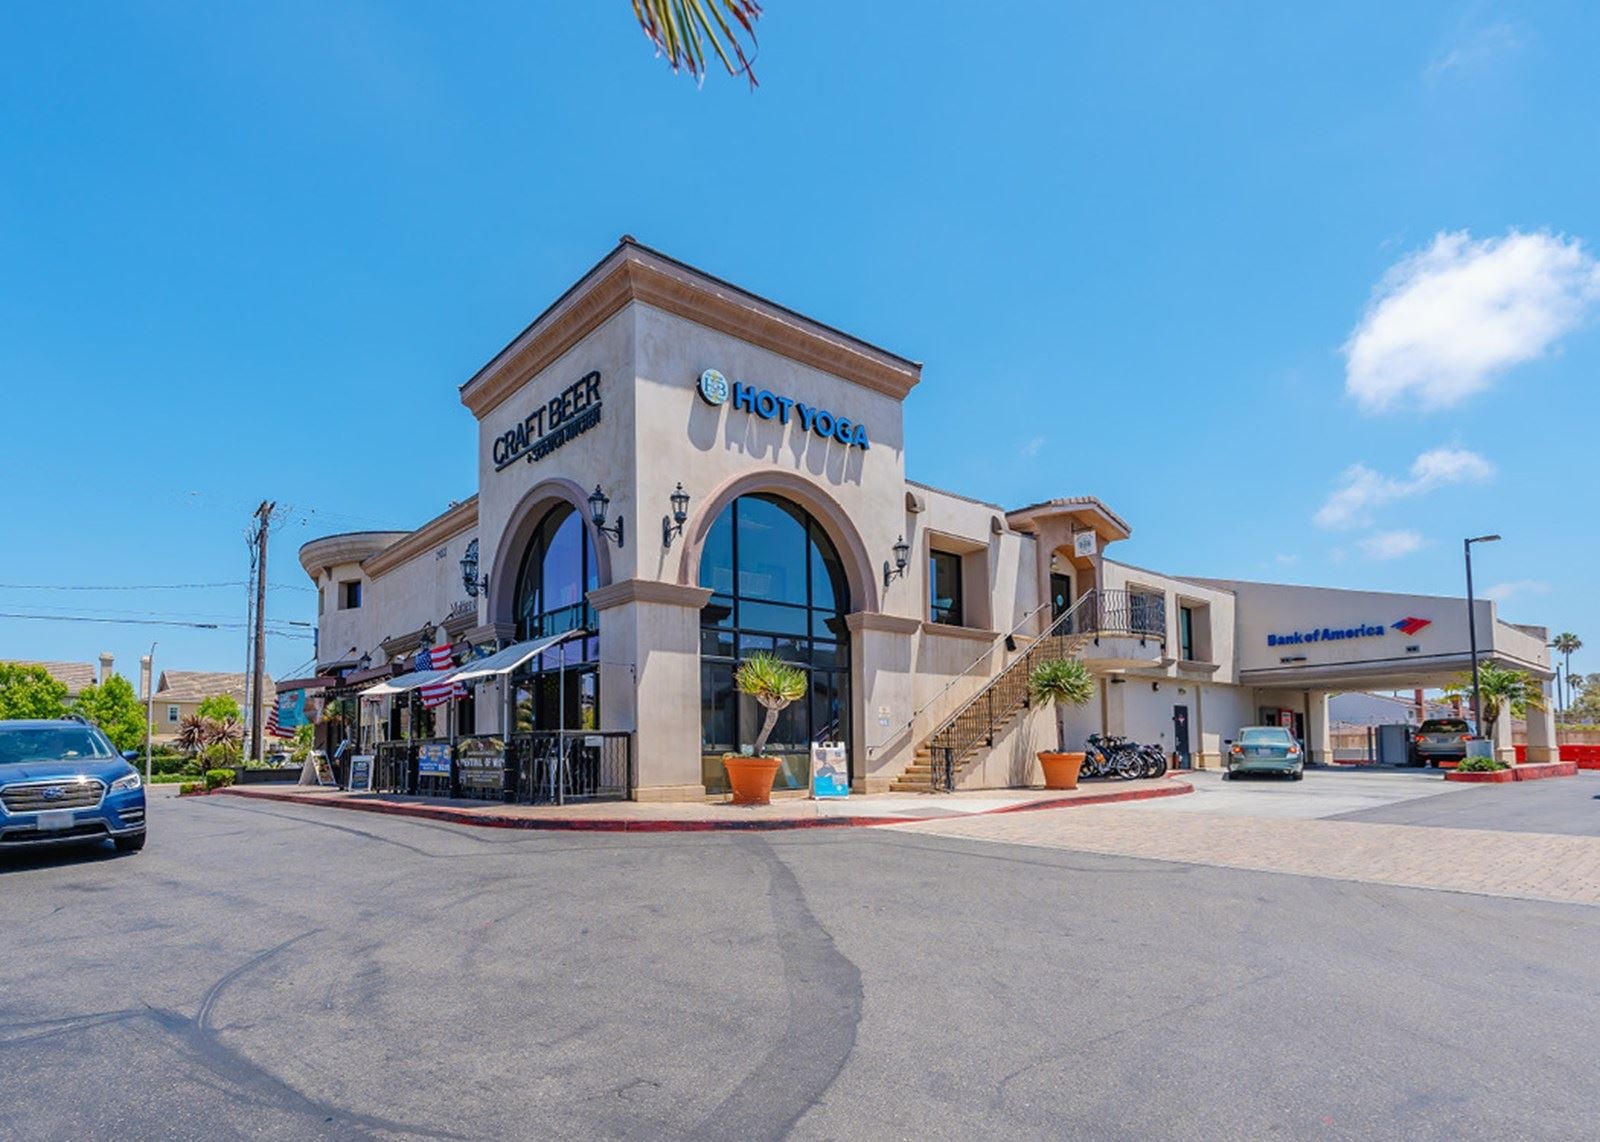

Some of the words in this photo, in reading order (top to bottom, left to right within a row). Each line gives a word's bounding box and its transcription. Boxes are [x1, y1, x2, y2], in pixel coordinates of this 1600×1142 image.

[493, 405, 547, 465] CRAFT
[548, 370, 601, 430] BEER
[733, 381, 794, 426] HOT
[795, 402, 871, 450] YOGA
[1267, 631, 1303, 647] Bank
[1303, 628, 1320, 643] of
[1320, 624, 1385, 641] America
